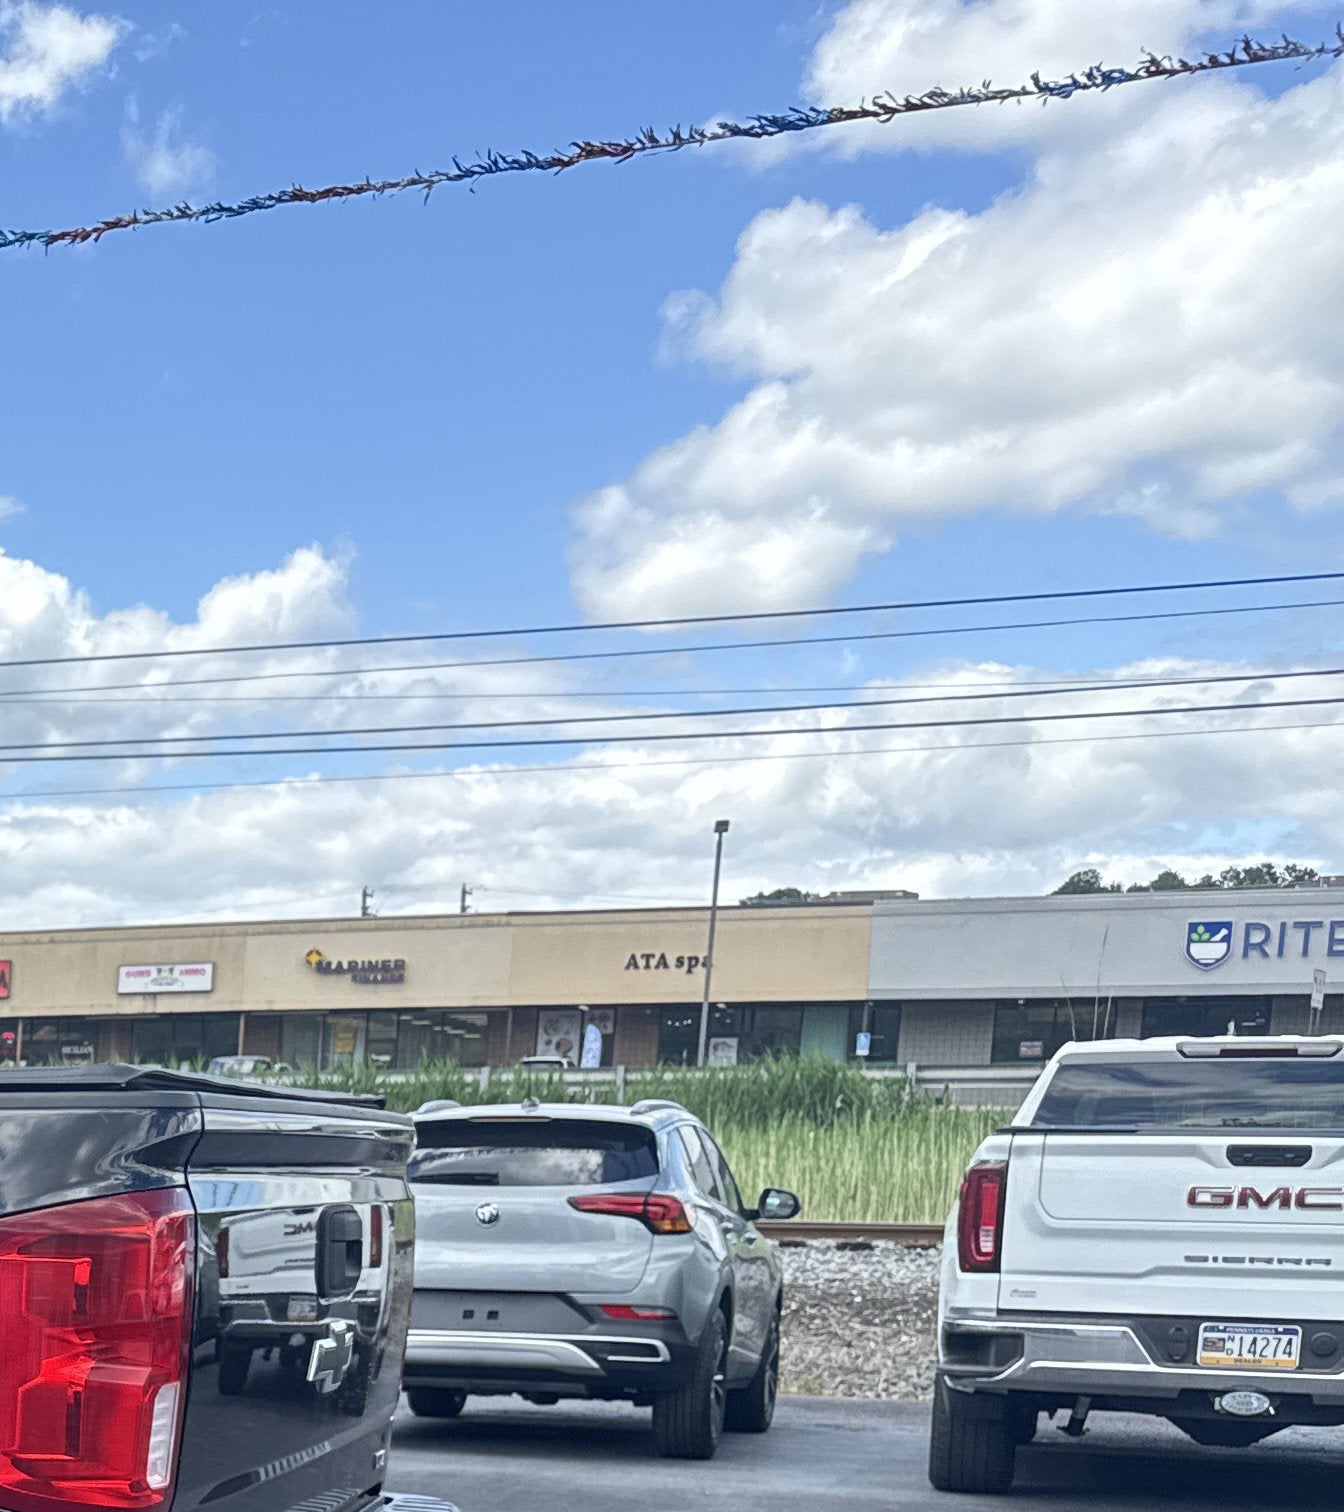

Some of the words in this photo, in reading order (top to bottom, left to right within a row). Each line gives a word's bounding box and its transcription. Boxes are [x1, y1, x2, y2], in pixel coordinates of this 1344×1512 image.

[1242, 920, 1344, 959] RITE
[316, 959, 405, 975] MARINER
[624, 952, 670, 971] ATA
[1186, 1185, 1344, 1211] GMC
[1184, 1254, 1332, 1266] SIERRA
[1237, 1335, 1294, 1359] 14274
